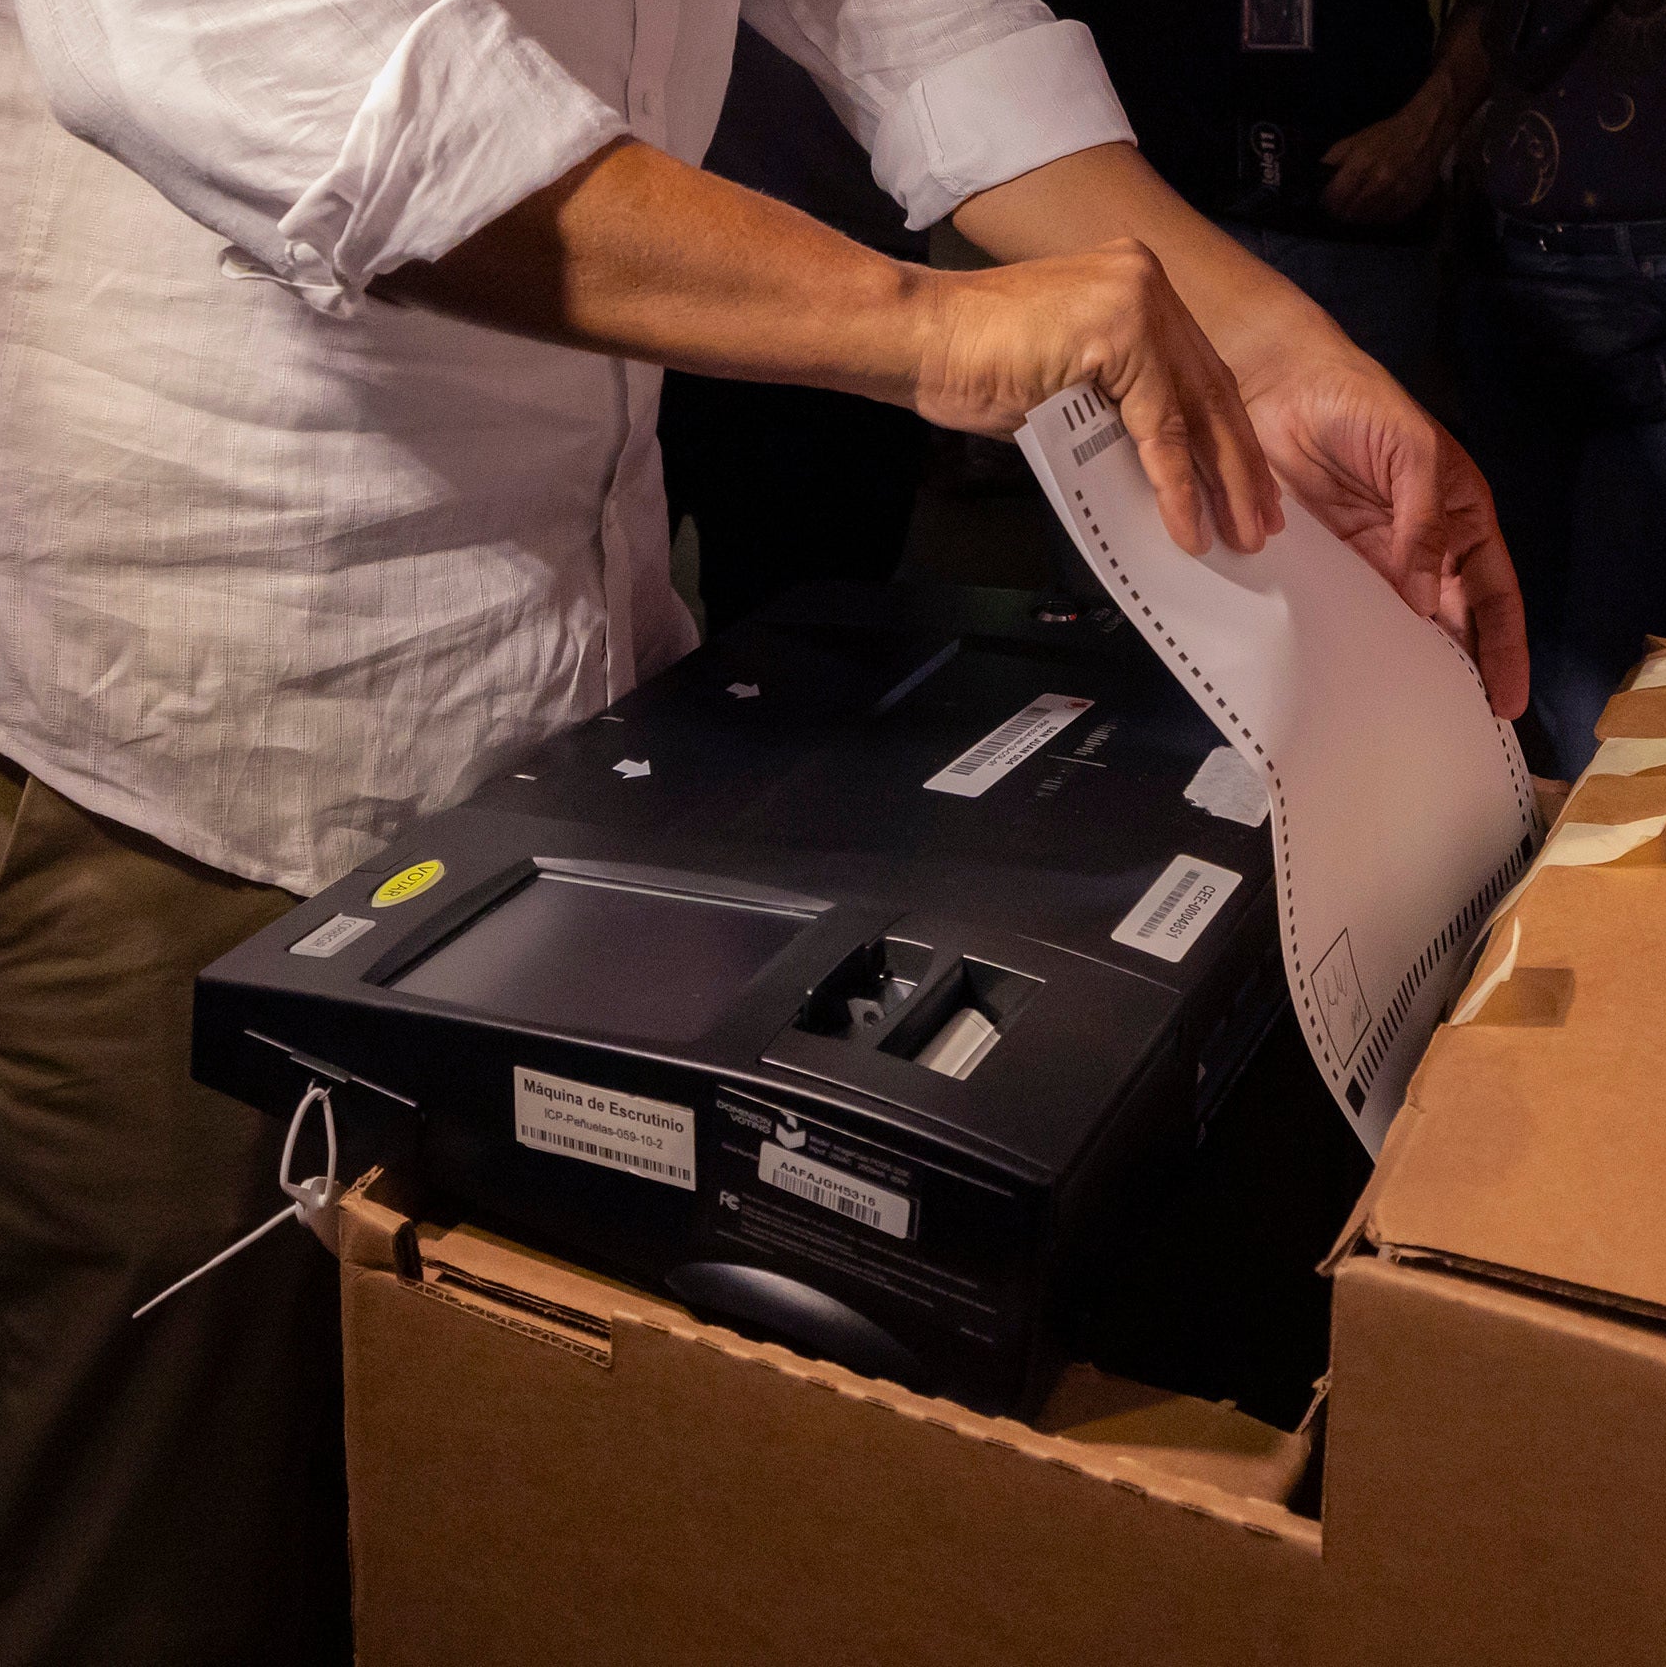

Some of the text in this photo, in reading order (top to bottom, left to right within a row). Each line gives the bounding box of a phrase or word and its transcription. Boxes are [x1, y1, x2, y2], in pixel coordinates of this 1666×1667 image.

[383, 865, 436, 898] VOTAR
[1166, 885, 1216, 939] CEE-0004851
[524, 1078, 685, 1133] Máquina de Escrutinio
[716, 1099, 772, 1128] DOMINION
[730, 1113, 771, 1134] VOTING
[544, 1107, 663, 1150] ICP-Peñuelas-059-10-2
